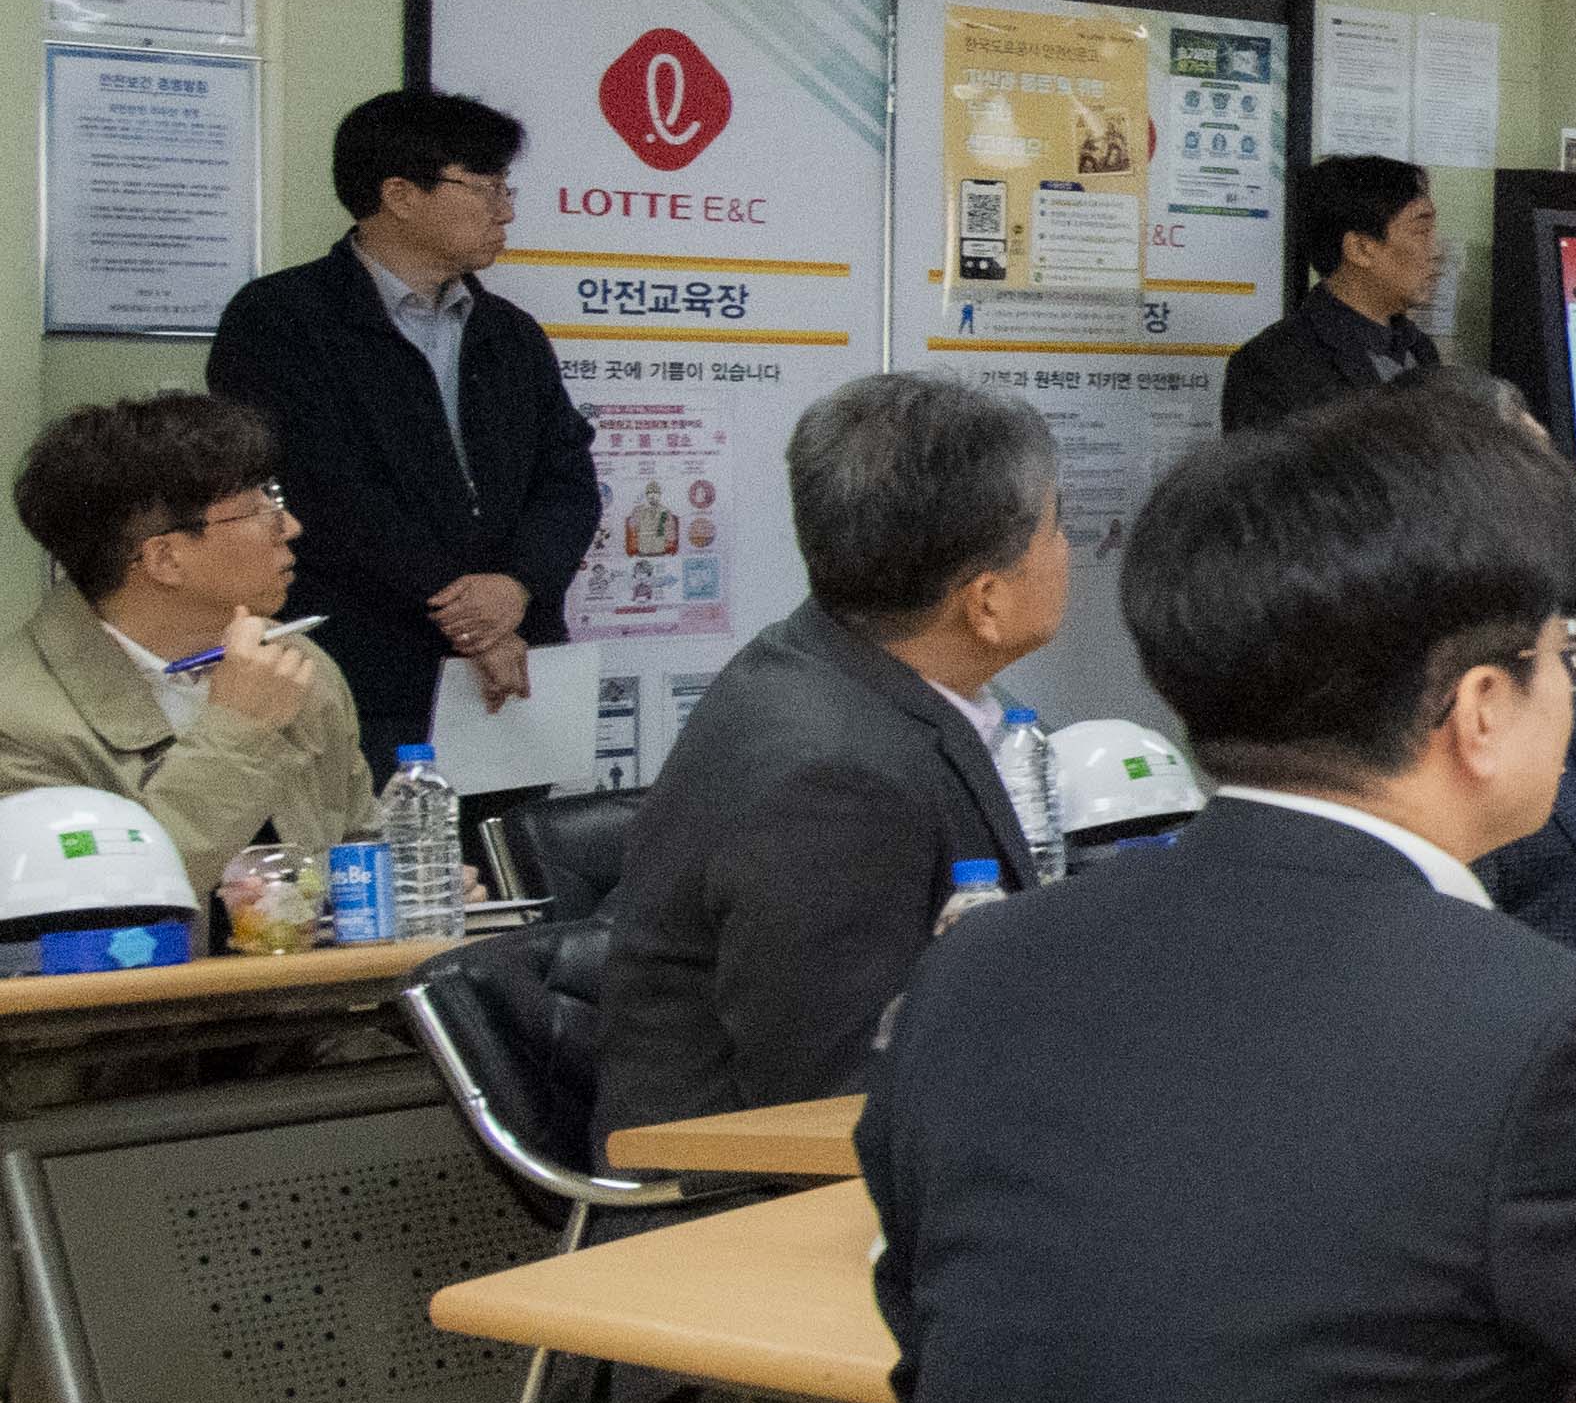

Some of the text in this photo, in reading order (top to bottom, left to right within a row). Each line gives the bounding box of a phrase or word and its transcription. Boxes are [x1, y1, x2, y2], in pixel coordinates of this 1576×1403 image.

[558, 186, 767, 224] LOTTE E&C
[577, 278, 750, 320] 안전교육장
[560, 359, 597, 380] 전한
[605, 359, 642, 382] 곳에
[711, 362, 781, 383] 있습니다
